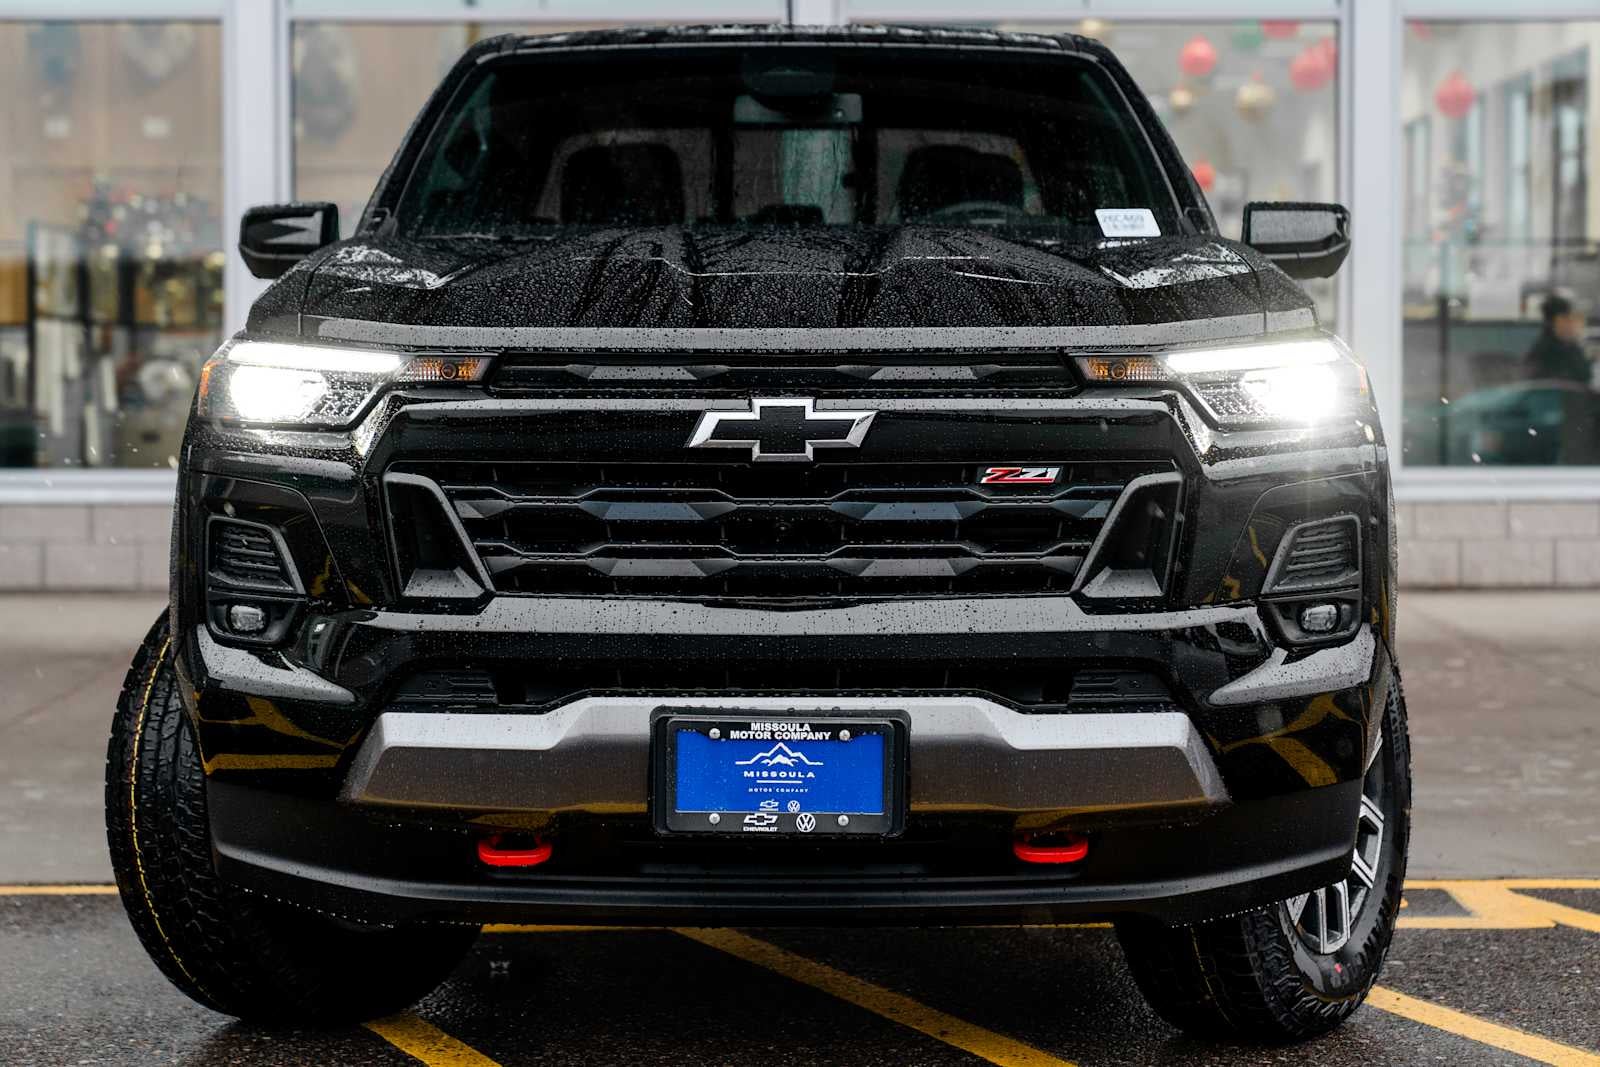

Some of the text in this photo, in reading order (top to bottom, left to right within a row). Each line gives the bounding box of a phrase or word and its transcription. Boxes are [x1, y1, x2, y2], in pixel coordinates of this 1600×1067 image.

[980, 467, 1060, 483] Z71
[751, 722, 811, 732] MISSOULA
[730, 730, 831, 740] MOTOR COMPANY
